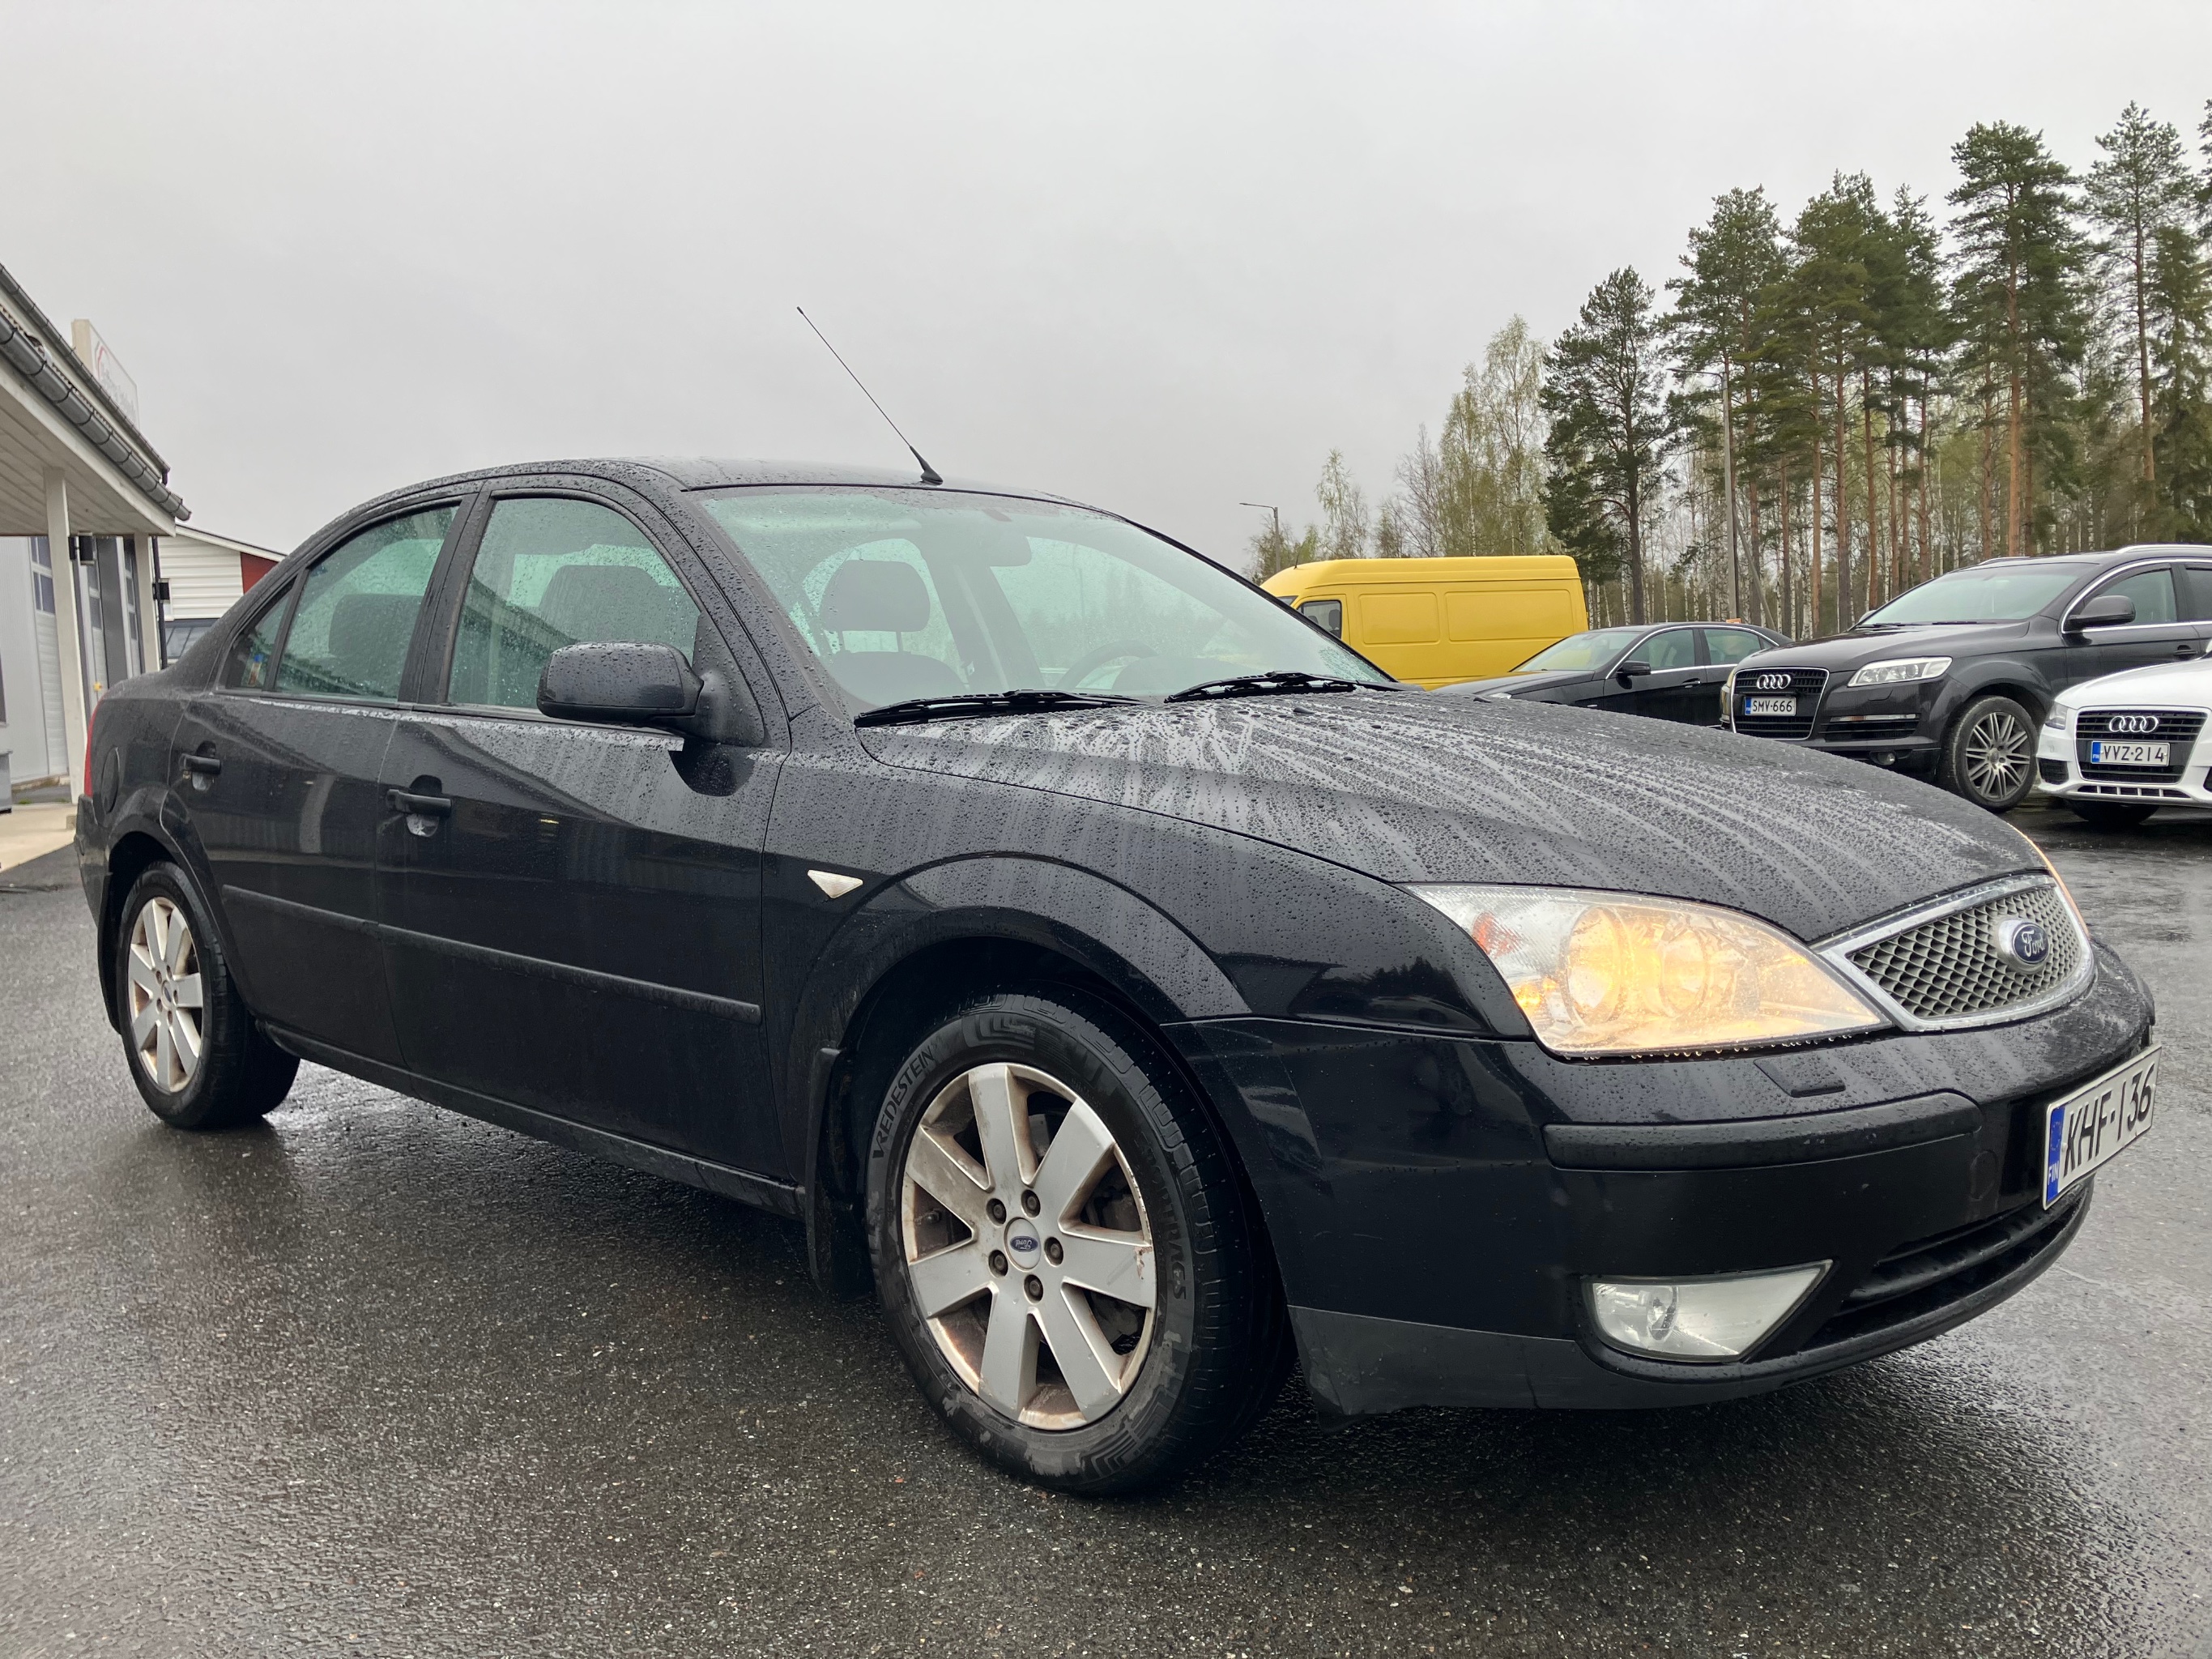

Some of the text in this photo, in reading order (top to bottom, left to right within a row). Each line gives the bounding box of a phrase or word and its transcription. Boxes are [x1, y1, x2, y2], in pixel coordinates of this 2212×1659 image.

[1753, 700, 1792, 712] SMV-666
[2103, 745, 2164, 762] VVZ-214
[2021, 929, 2046, 957] Ford
[872, 1045, 936, 1159] VREDESTEIN
[2063, 1063, 2155, 1179] KHF-136
[2048, 1160, 2060, 1186] FIN
[1015, 1239, 1033, 1250] Ford
